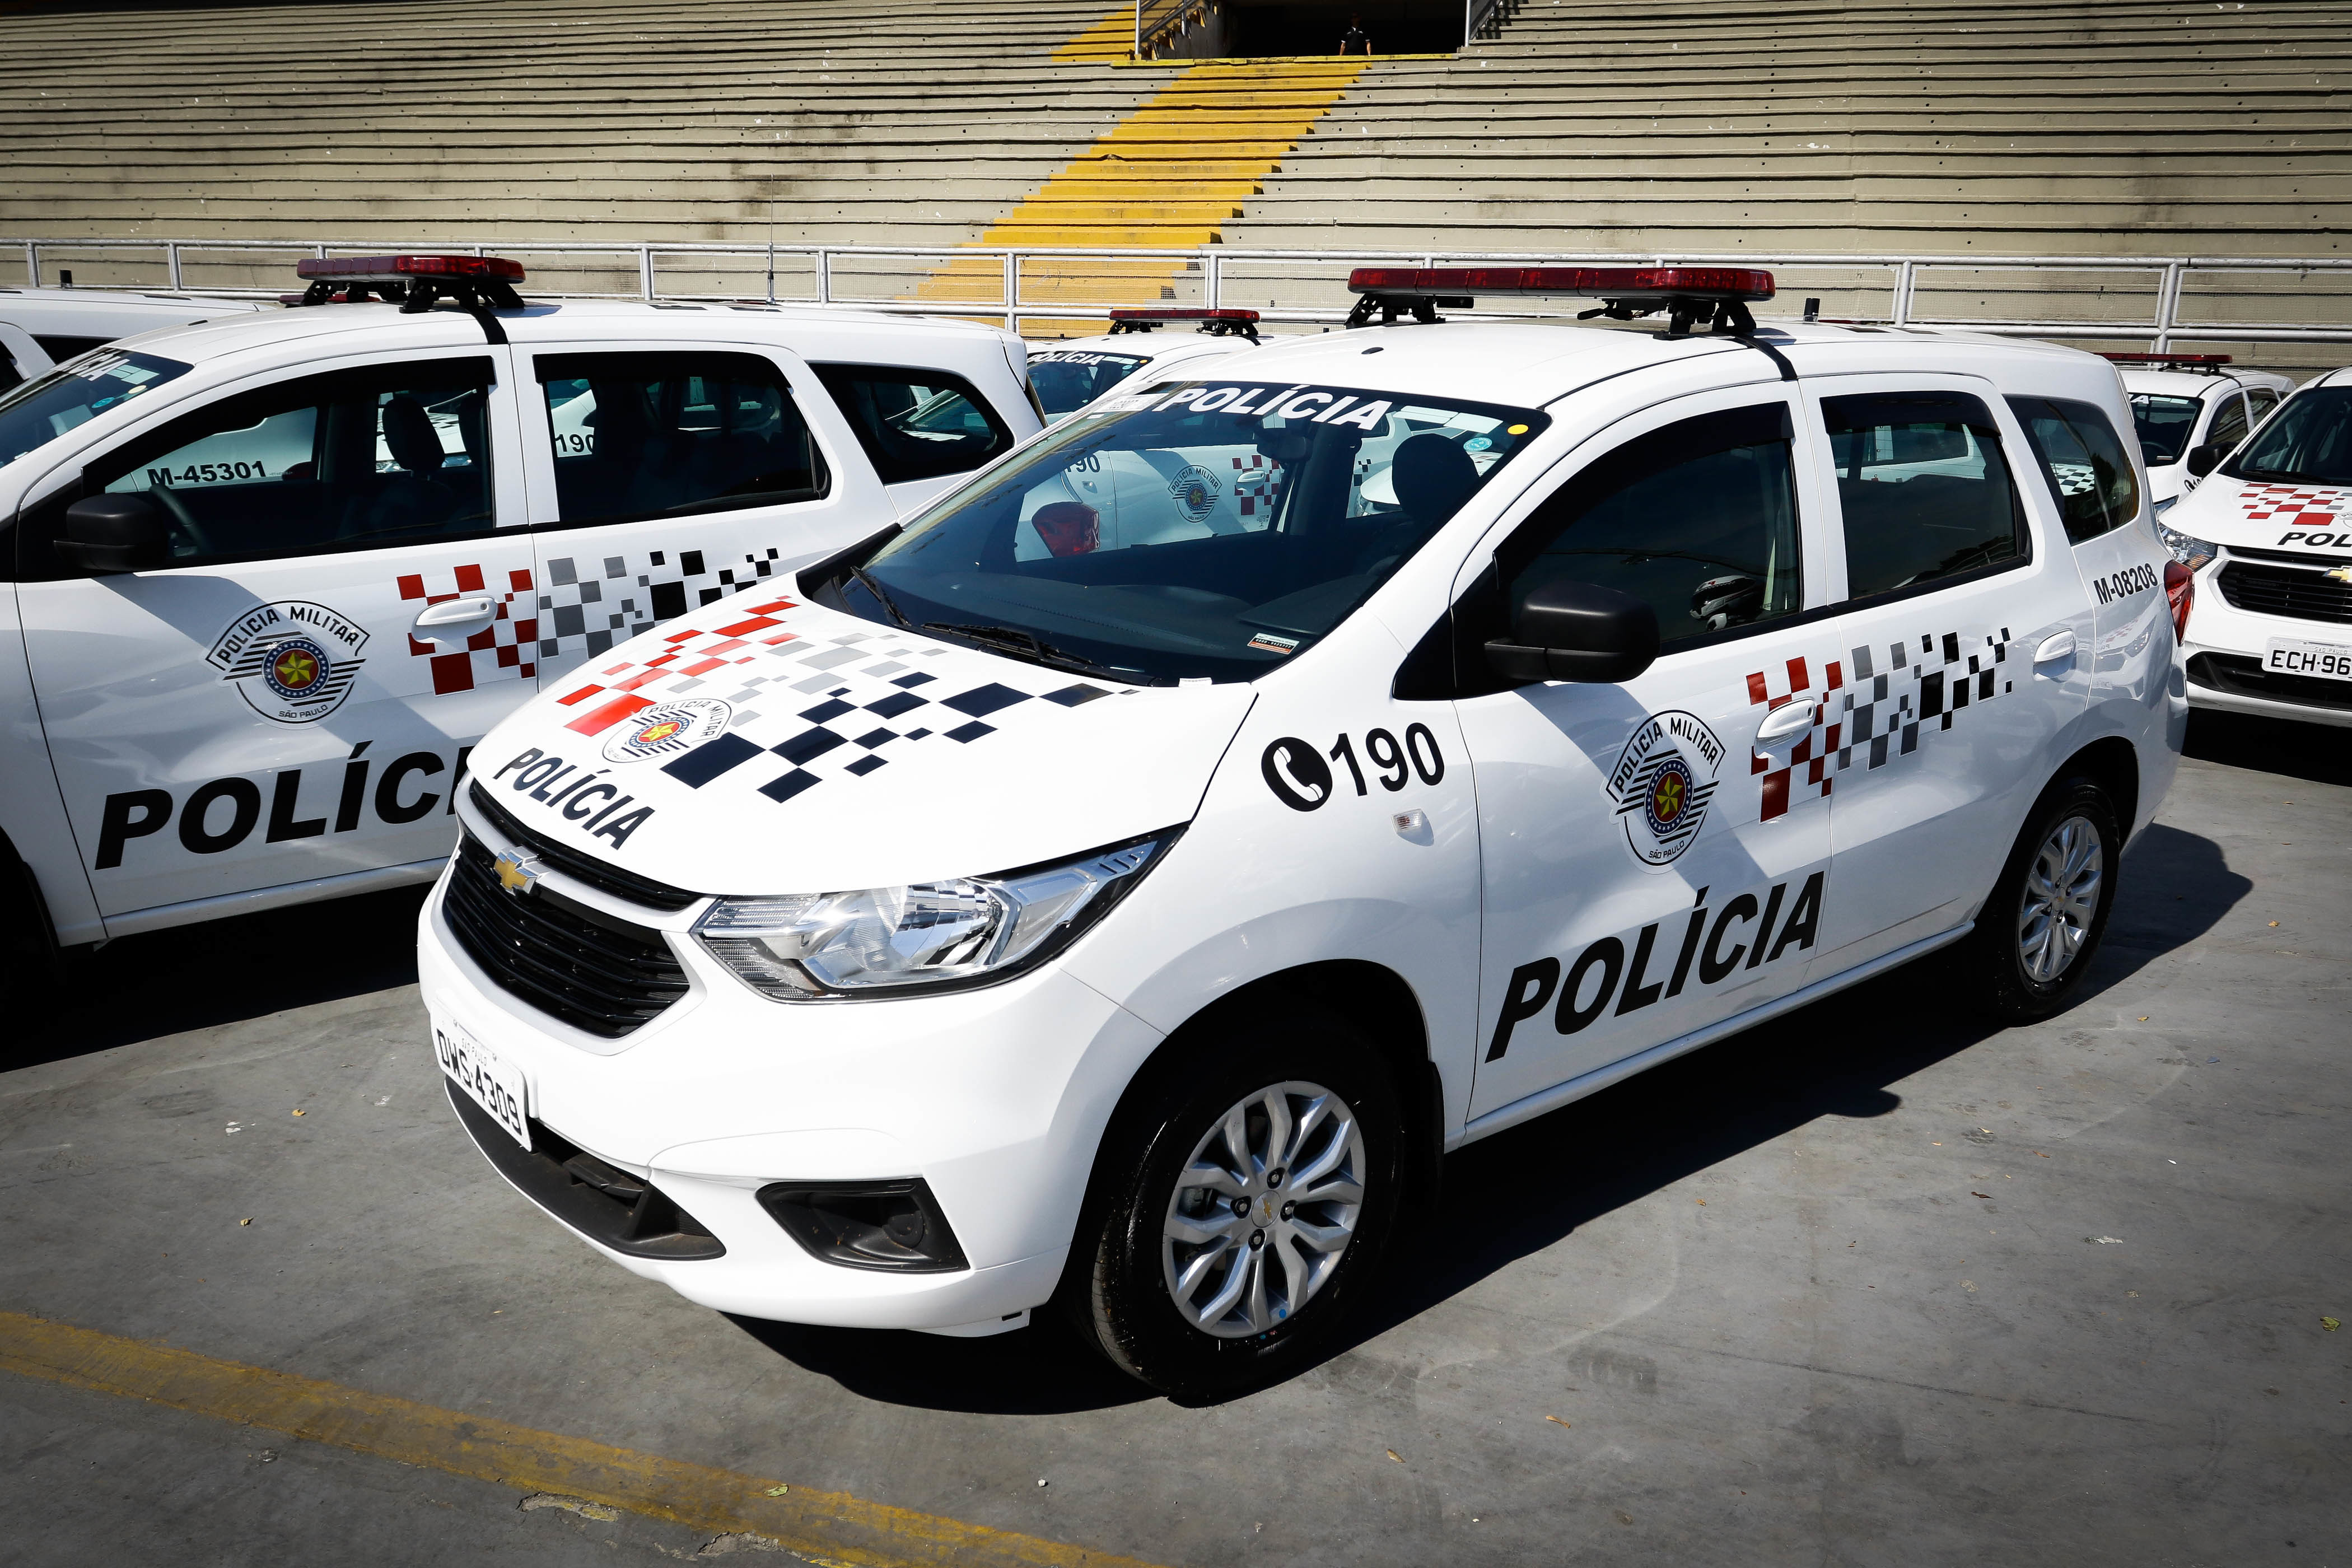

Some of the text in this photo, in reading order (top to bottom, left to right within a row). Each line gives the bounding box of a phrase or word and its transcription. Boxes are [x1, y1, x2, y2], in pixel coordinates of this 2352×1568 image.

[1152, 385, 1392, 430] POLÍCIA
[147, 460, 267, 486] M-45301
[1196, 467, 1219, 489] MILITAR
[2093, 563, 2158, 605] M-08208
[216, 606, 360, 664] POLÍCIA MILITAR
[300, 704, 328, 718] PAULO
[699, 705, 725, 737] MILITAR
[1329, 722, 1445, 797] 190
[1614, 717, 1718, 794] POLÍCIA MILITAR
[493, 748, 656, 850] POLÍCIA
[1649, 840, 1685, 859] SÃO PAULO
[1485, 871, 1825, 1064] POLÍCIA
